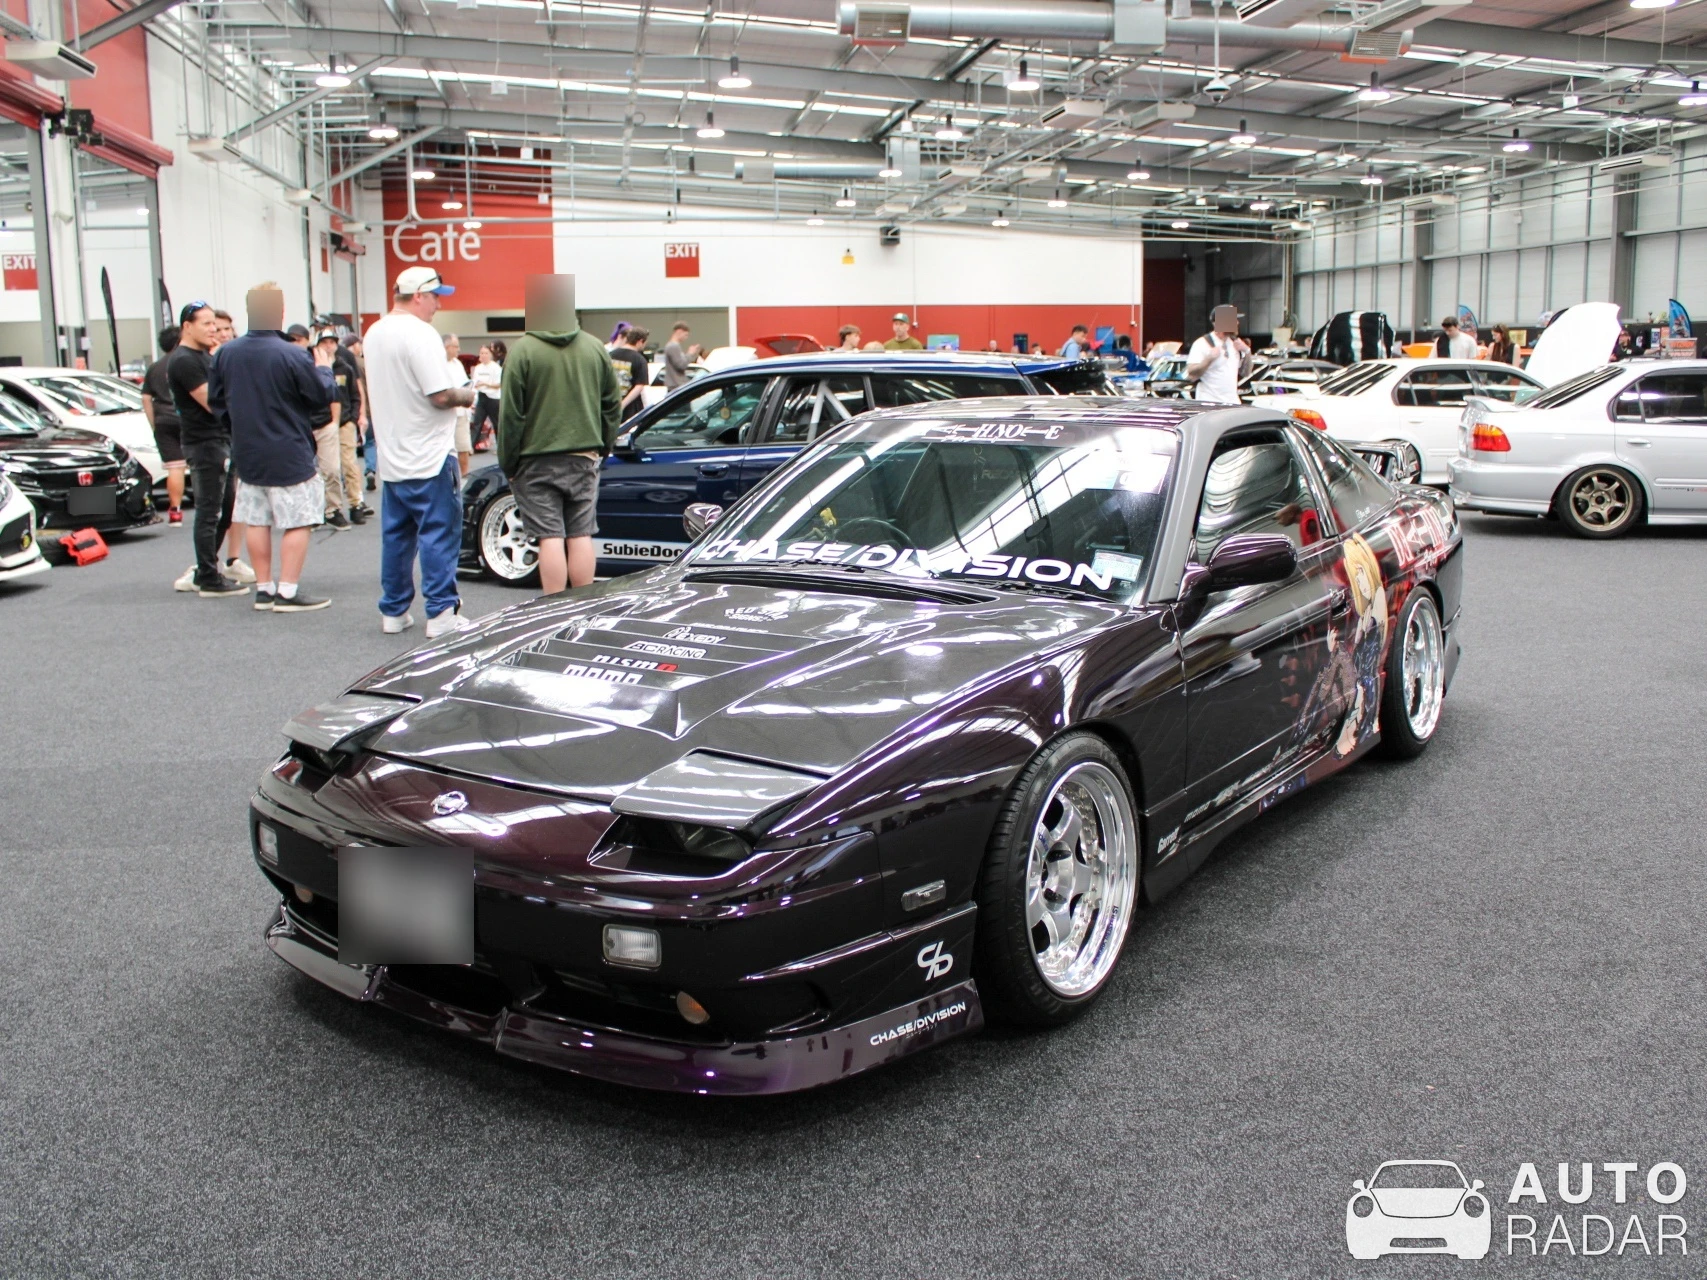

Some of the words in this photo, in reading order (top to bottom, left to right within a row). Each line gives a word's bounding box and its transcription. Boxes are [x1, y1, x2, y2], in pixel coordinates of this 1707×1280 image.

[665, 243, 698, 258] EXIT
[3, 255, 36, 270] EXIT
[655, 644, 703, 659] RACING
[870, 1002, 966, 1046] CHASE/DIVISION
